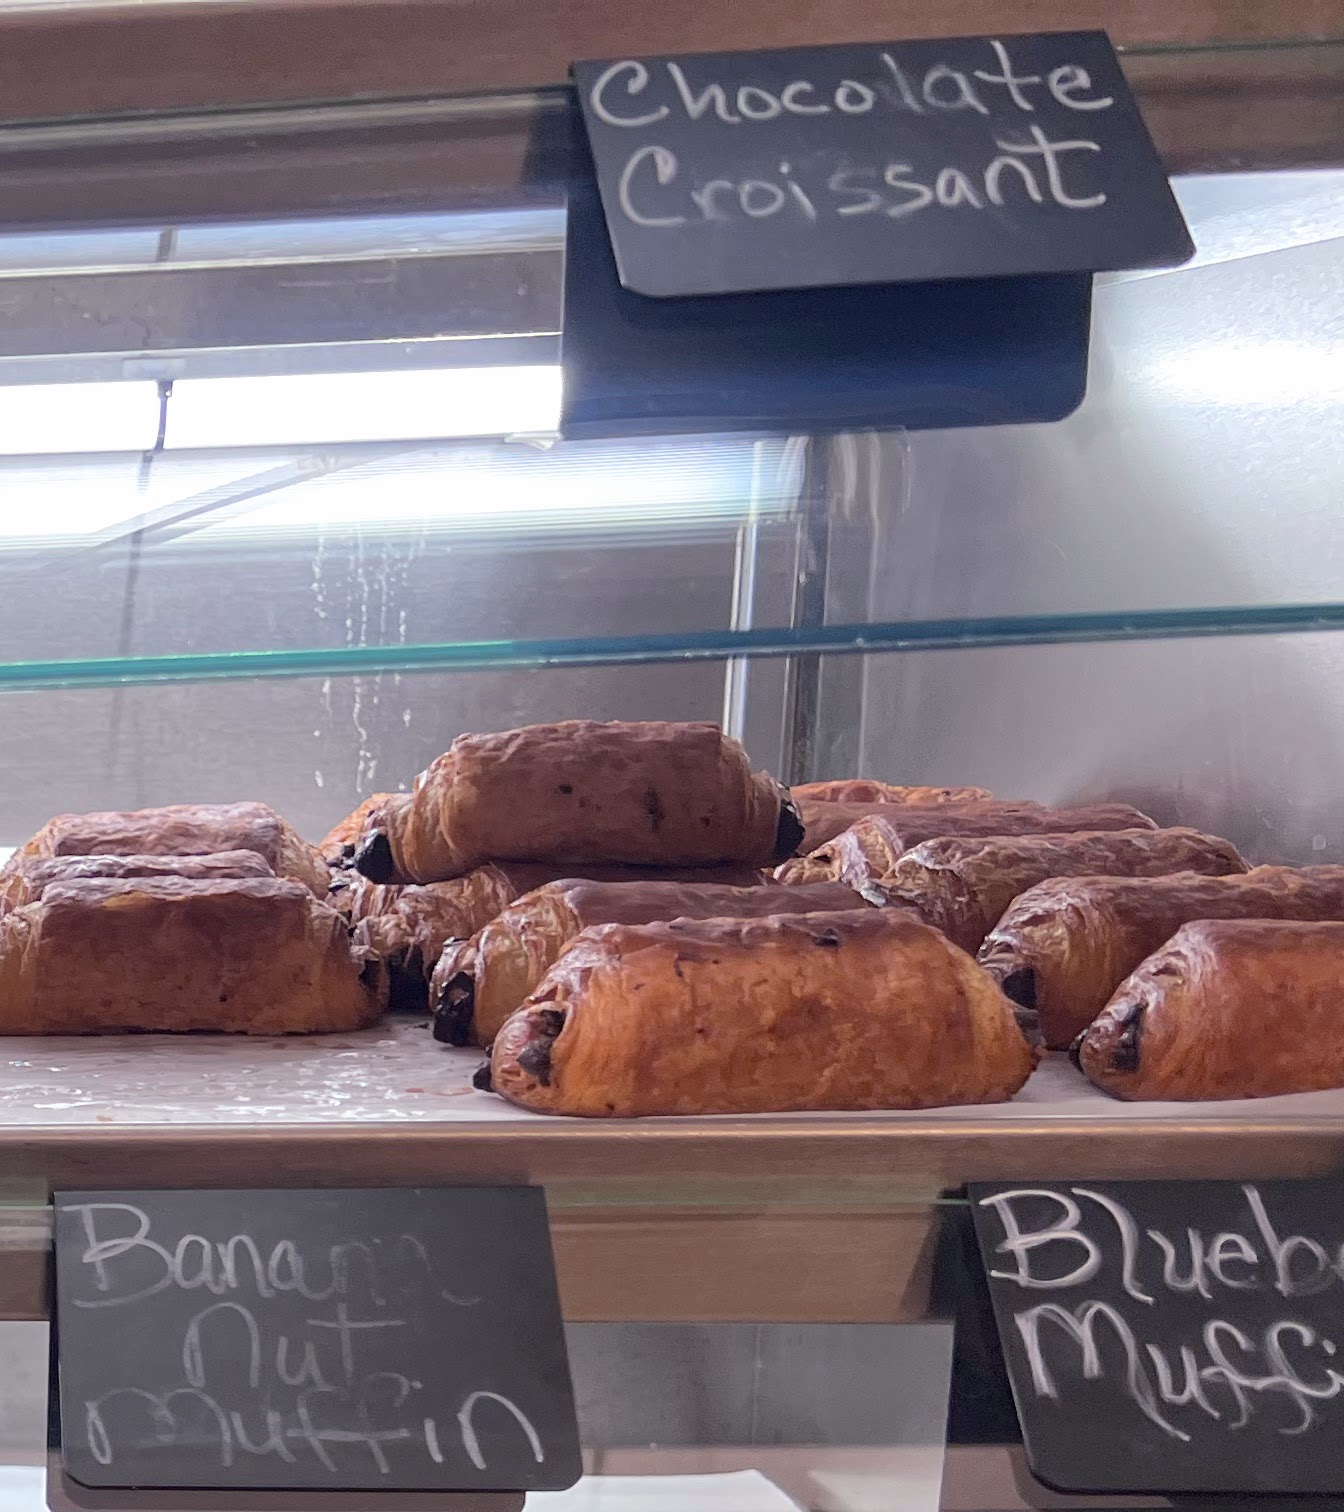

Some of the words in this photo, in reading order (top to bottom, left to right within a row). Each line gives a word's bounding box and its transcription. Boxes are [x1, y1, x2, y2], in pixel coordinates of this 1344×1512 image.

[590, 39, 1113, 128] Chocolate
[619, 125, 1106, 226] Croissant
[978, 1183, 1344, 1306] Blueb
